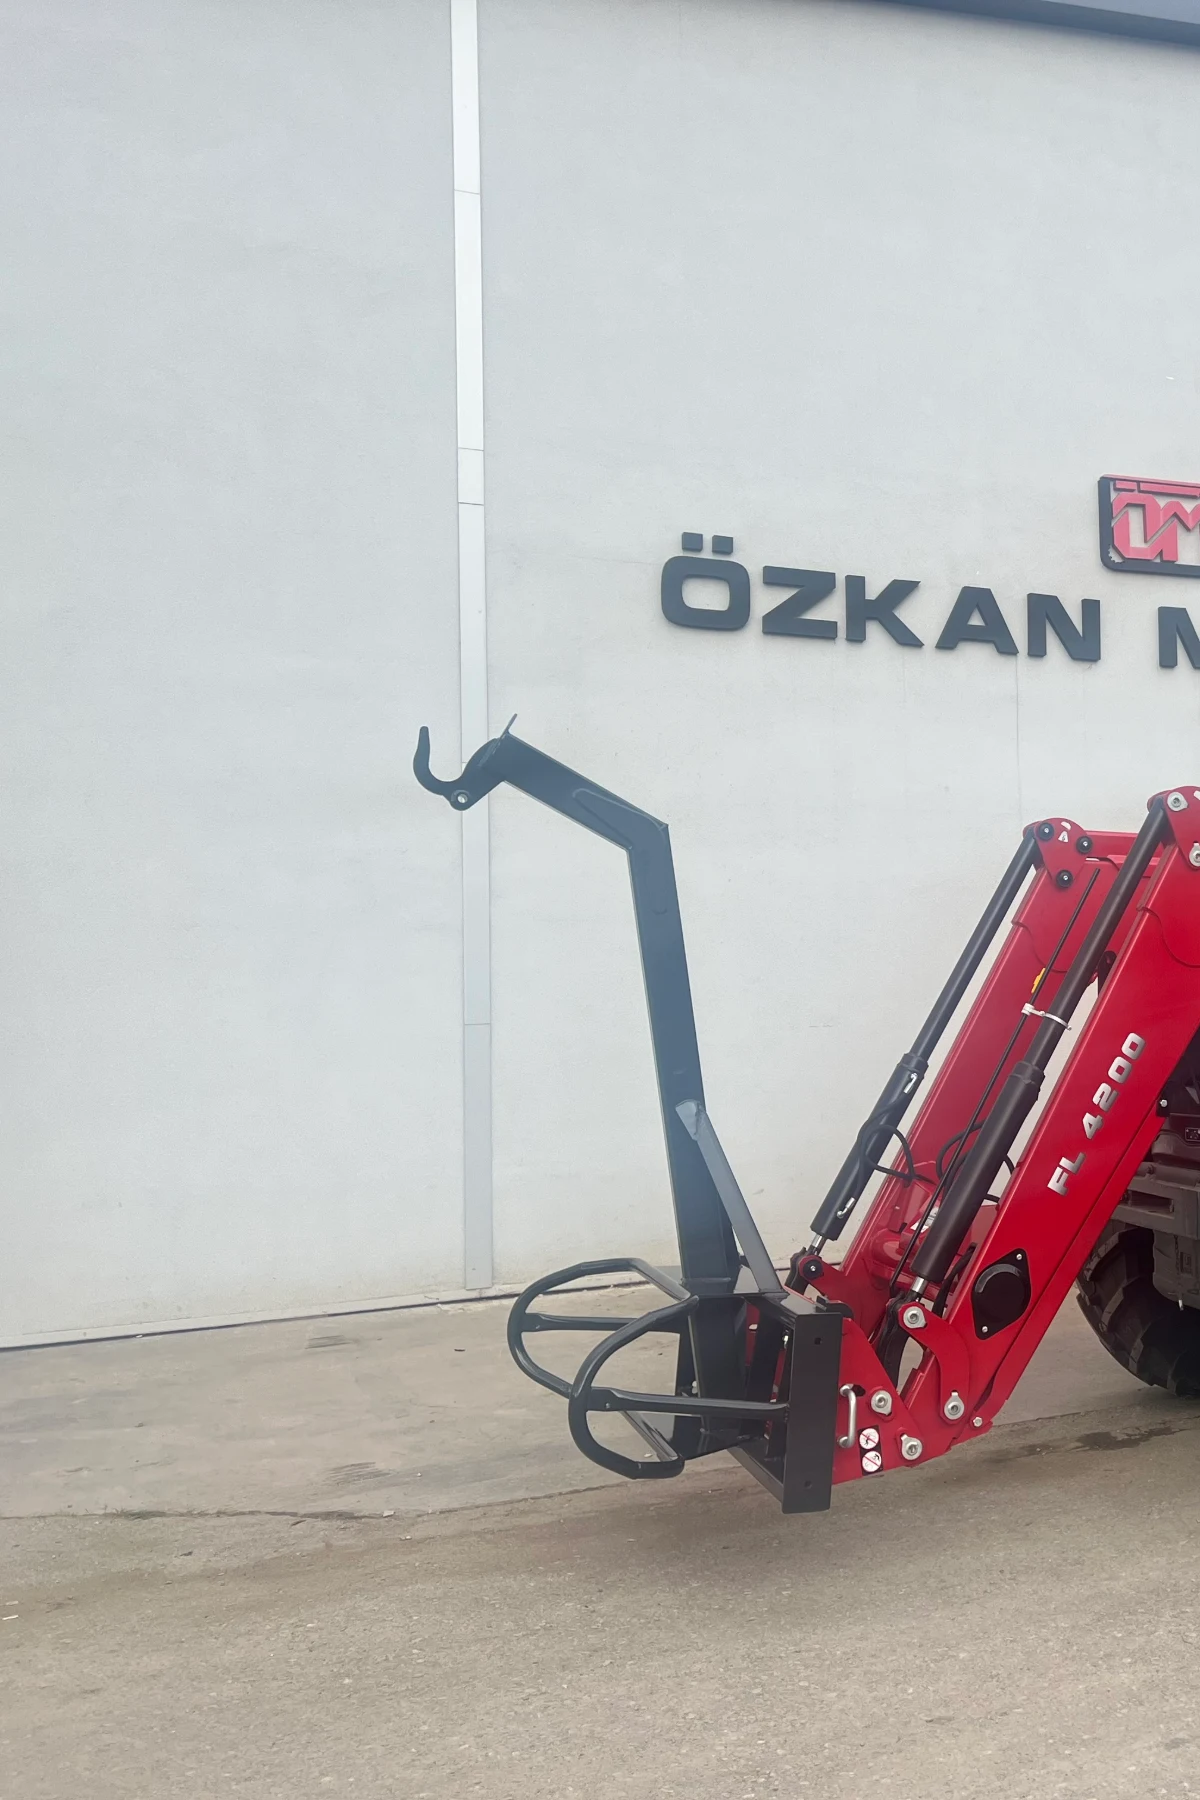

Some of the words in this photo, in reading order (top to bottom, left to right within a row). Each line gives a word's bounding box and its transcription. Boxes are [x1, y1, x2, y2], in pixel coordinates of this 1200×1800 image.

[660, 532, 1101, 662] ÖZKAN
[1047, 1152, 1087, 1196] FL
[1082, 1032, 1147, 1140] 4200
